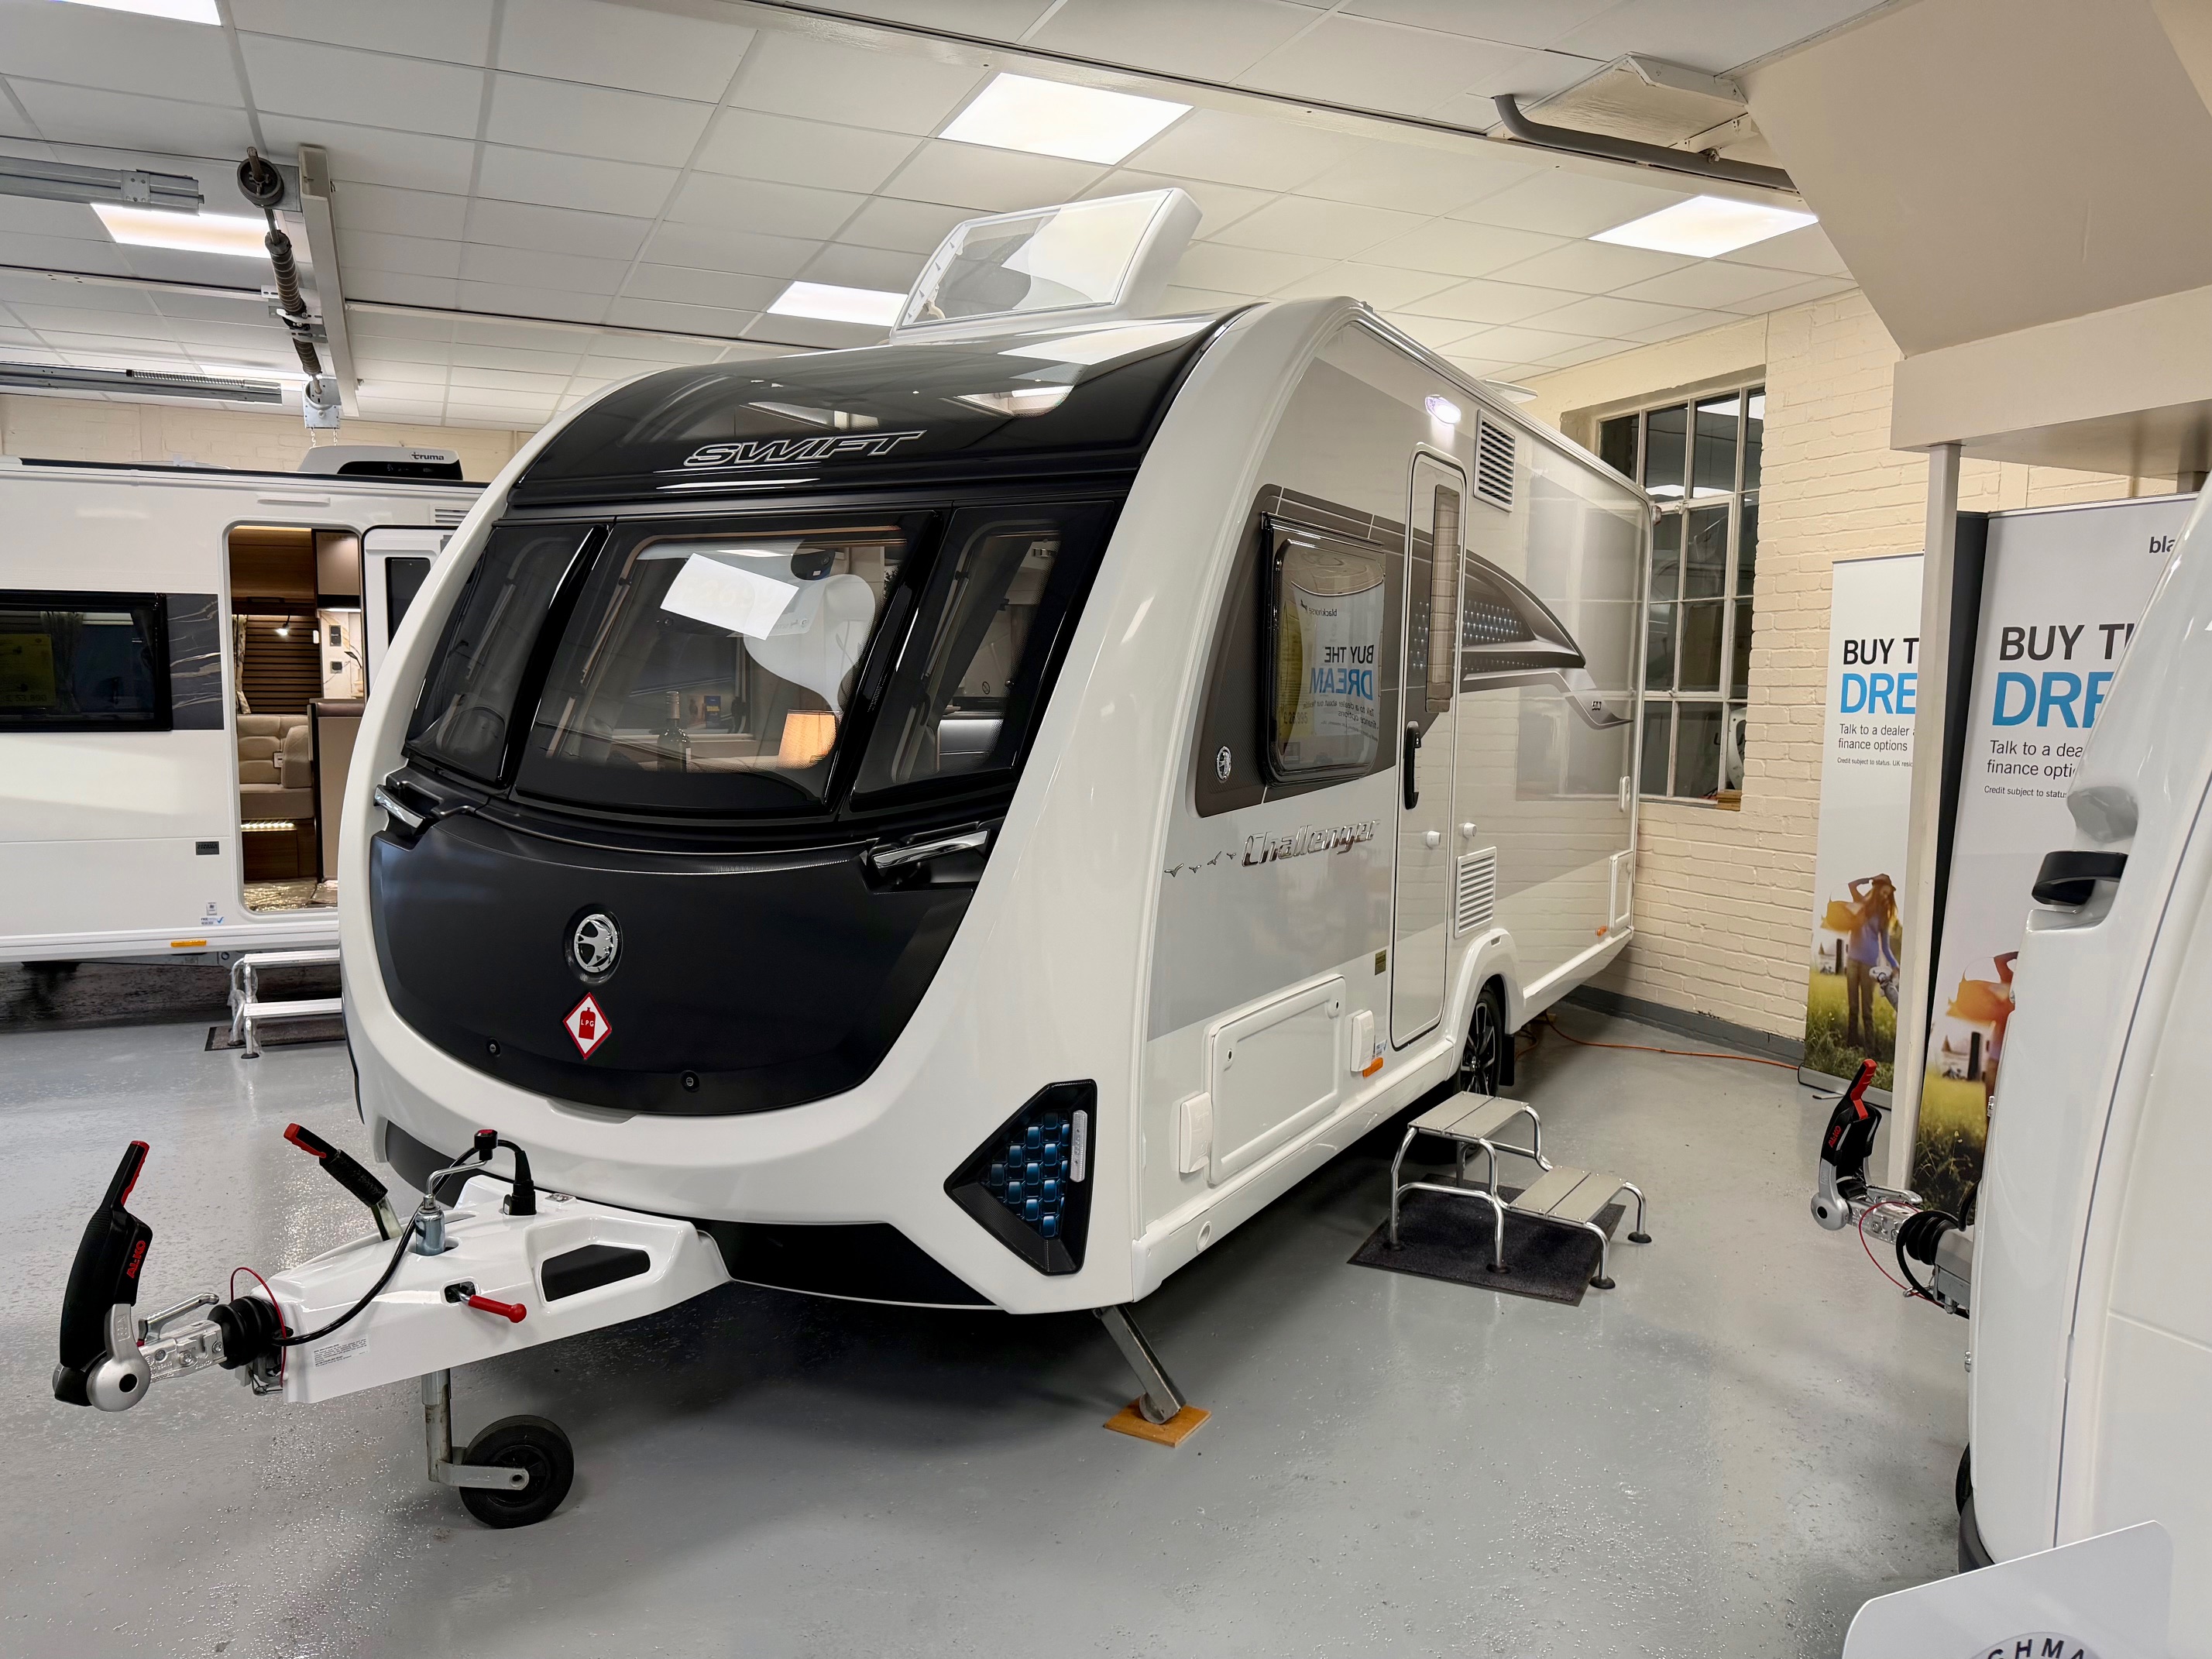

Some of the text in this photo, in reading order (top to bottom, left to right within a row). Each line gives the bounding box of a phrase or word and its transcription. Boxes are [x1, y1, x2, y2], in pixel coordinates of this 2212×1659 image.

[684, 429, 928, 467] SWIFT
[410, 452, 445, 461] truma
[1999, 624, 2085, 661] BUY
[1843, 637, 1920, 665] BUY T
[1840, 672, 1918, 715] DRE
[1839, 723, 1857, 735] Talk
[1860, 725, 1869, 736] to
[1872, 726, 1877, 735] a
[1881, 725, 1910, 737] dealer
[1838, 737, 1908, 753] finance options
[1990, 740, 2018, 754] Talk
[2023, 742, 2037, 756] to
[2042, 745, 2050, 756] a
[1987, 759, 2039, 775] finance
[1984, 785, 2005, 795] Credit
[2008, 788, 2034, 797] subject
[1242, 819, 1381, 867] Challenger
[581, 1018, 595, 1028] LPG
[126, 1240, 146, 1279] AL-KO
